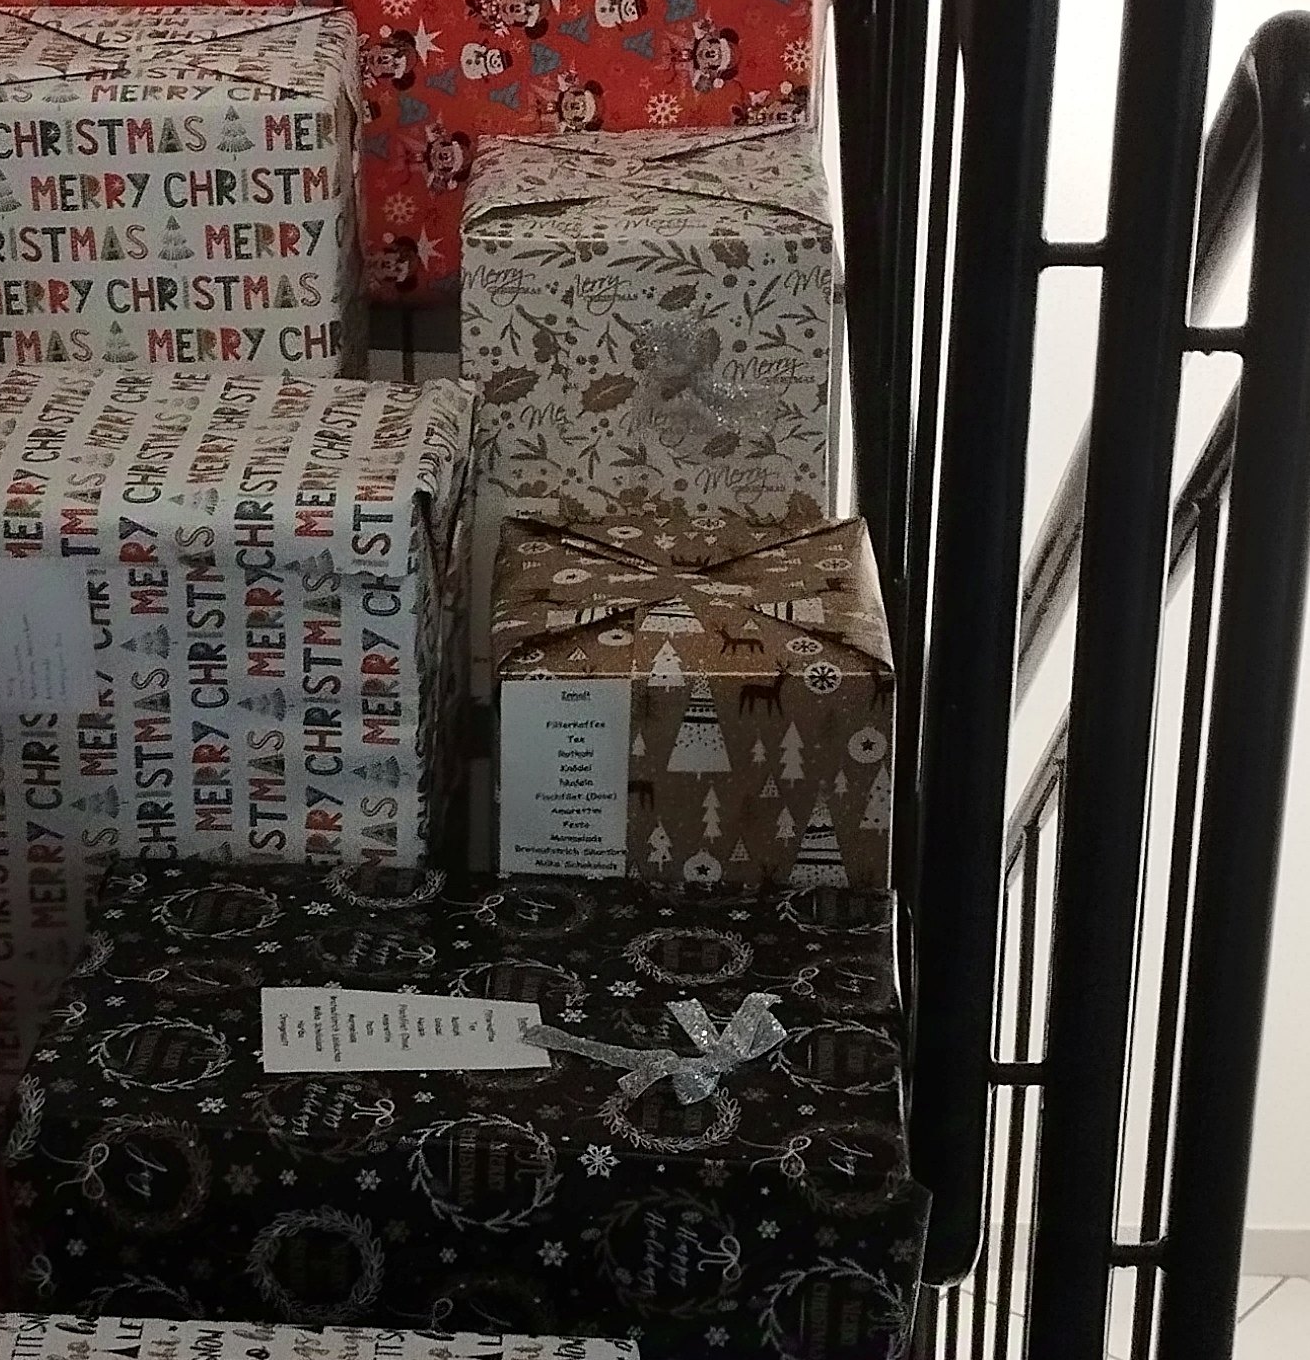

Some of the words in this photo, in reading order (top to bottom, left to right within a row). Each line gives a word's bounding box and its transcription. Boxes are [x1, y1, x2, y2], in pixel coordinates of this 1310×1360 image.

[91, 84, 215, 102] MERRY
[31, 172, 151, 212] MERRY
[205, 220, 325, 260] MERRY
[106, 273, 322, 315] CHRISTMAS
[148, 327, 266, 364] MERRY
[245, 568, 287, 678] MERRY
[302, 572, 343, 777] CHRISTMAS
[361, 627, 402, 745] MERRY
[191, 721, 233, 831] MERRY
[26, 820, 67, 930] MERRY
[669, 1224, 700, 1288] Happy
